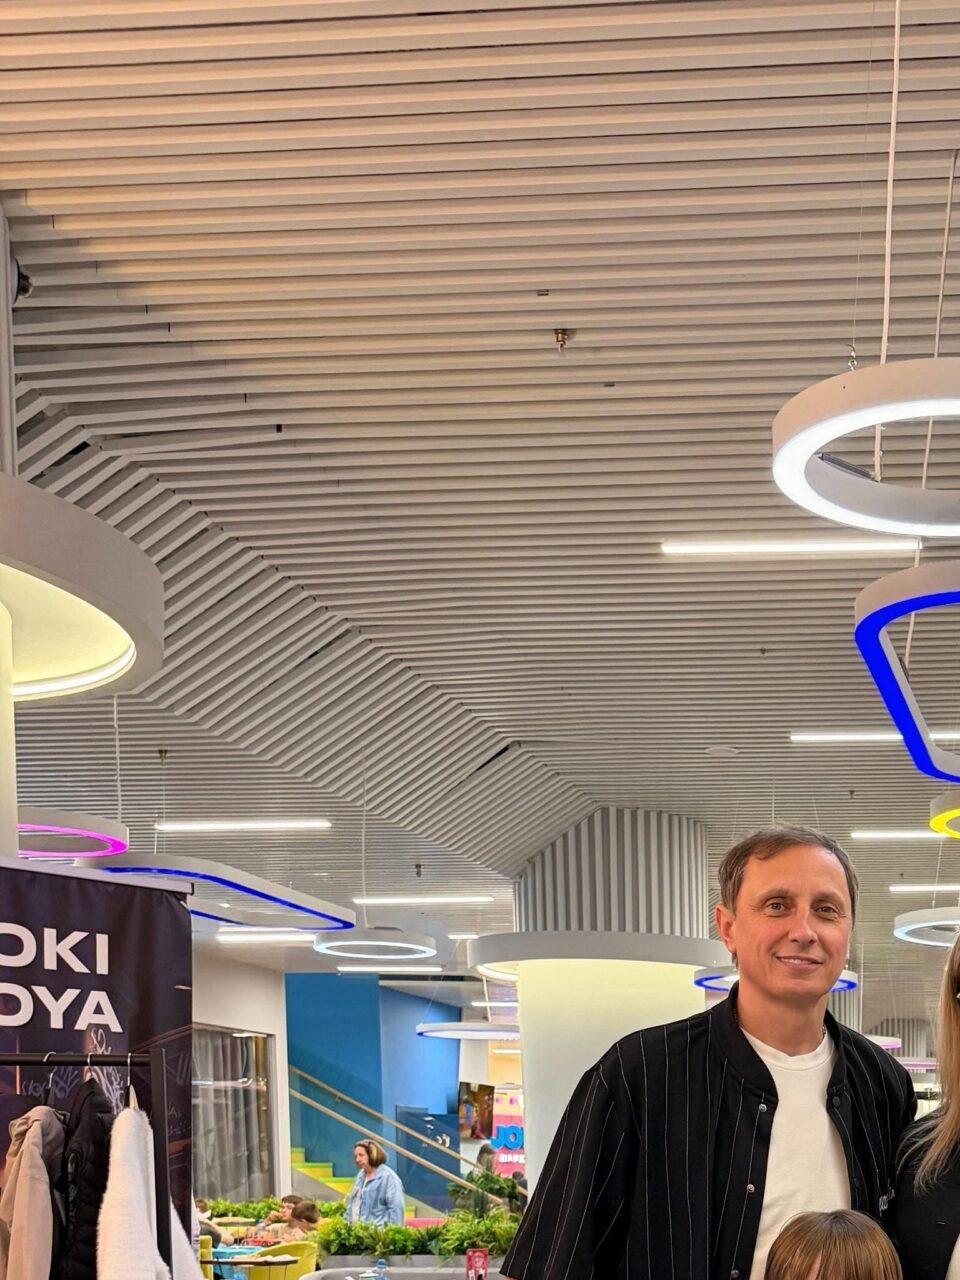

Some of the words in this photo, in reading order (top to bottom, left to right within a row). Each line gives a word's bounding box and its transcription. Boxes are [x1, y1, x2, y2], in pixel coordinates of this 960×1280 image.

[0, 922, 110, 976] OKI
[0, 982, 124, 1033] OYA
[489, 1123, 525, 1150] JO
